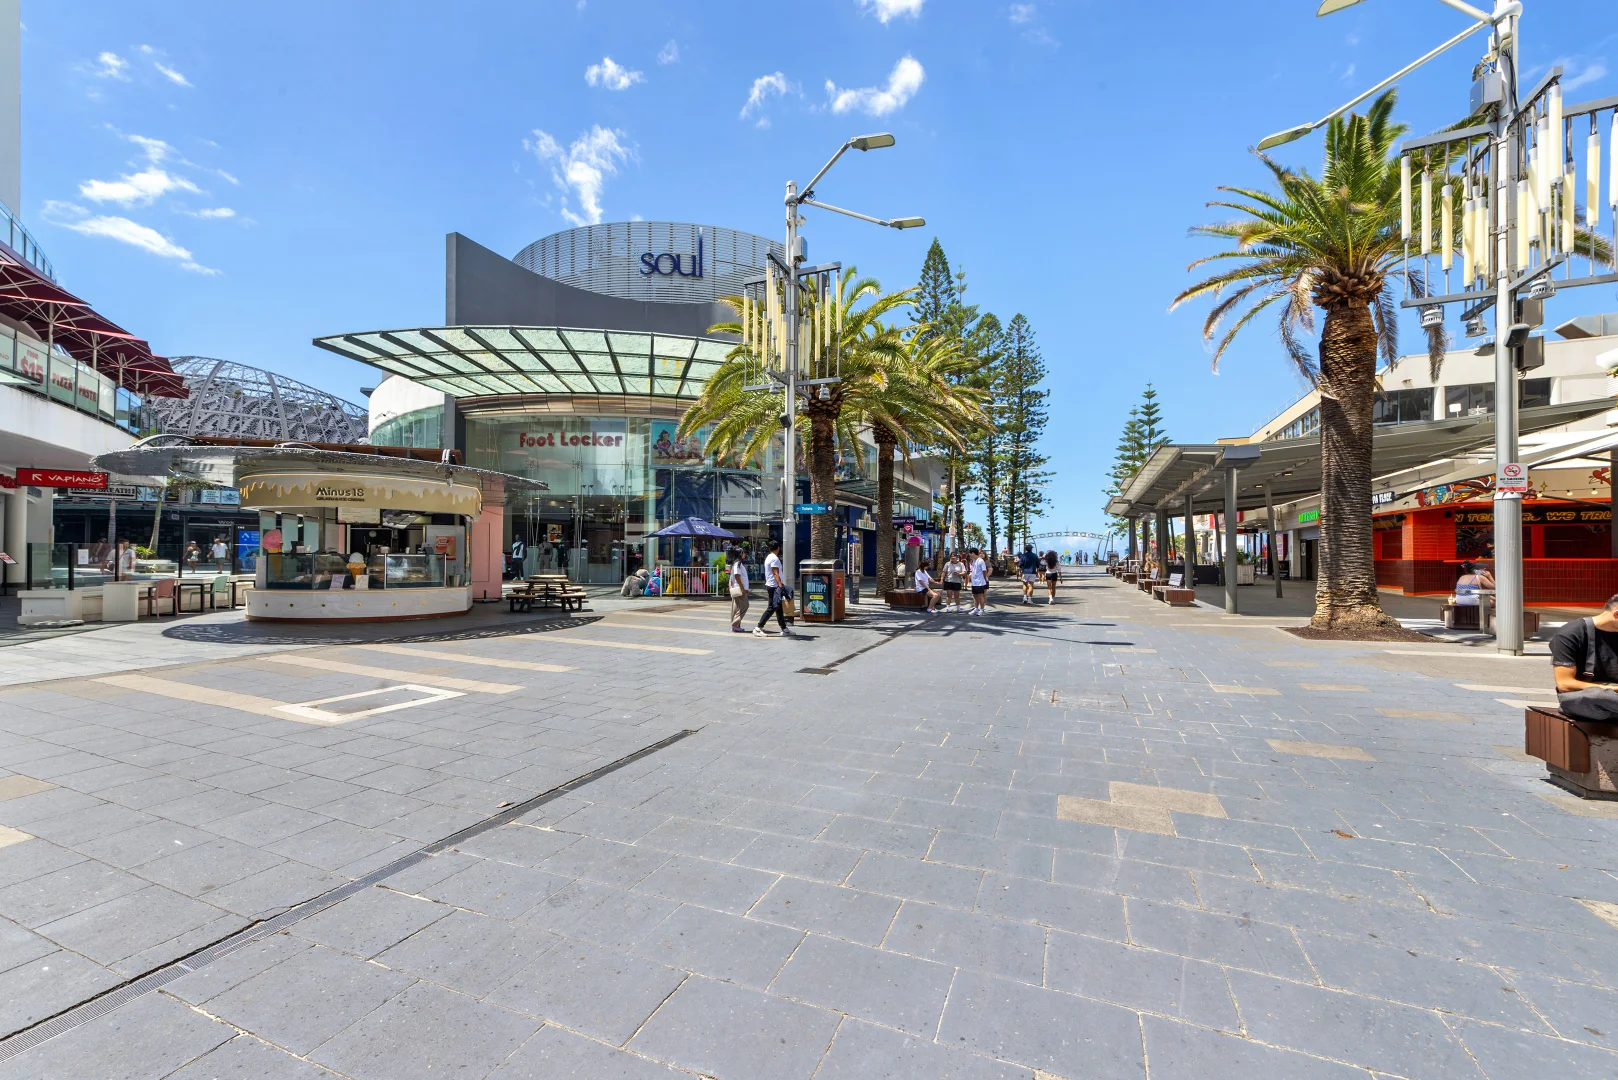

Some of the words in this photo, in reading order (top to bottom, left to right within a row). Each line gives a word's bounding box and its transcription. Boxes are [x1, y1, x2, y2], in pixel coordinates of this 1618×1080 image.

[640, 227, 704, 279] soul
[52, 371, 73, 391] PIZZA
[78, 386, 97, 402] PASTA
[519, 432, 555, 448] Foot
[560, 431, 623, 448] Locker
[48, 474, 103, 483] VAPIANO
[1579, 511, 1612, 521] TRU
